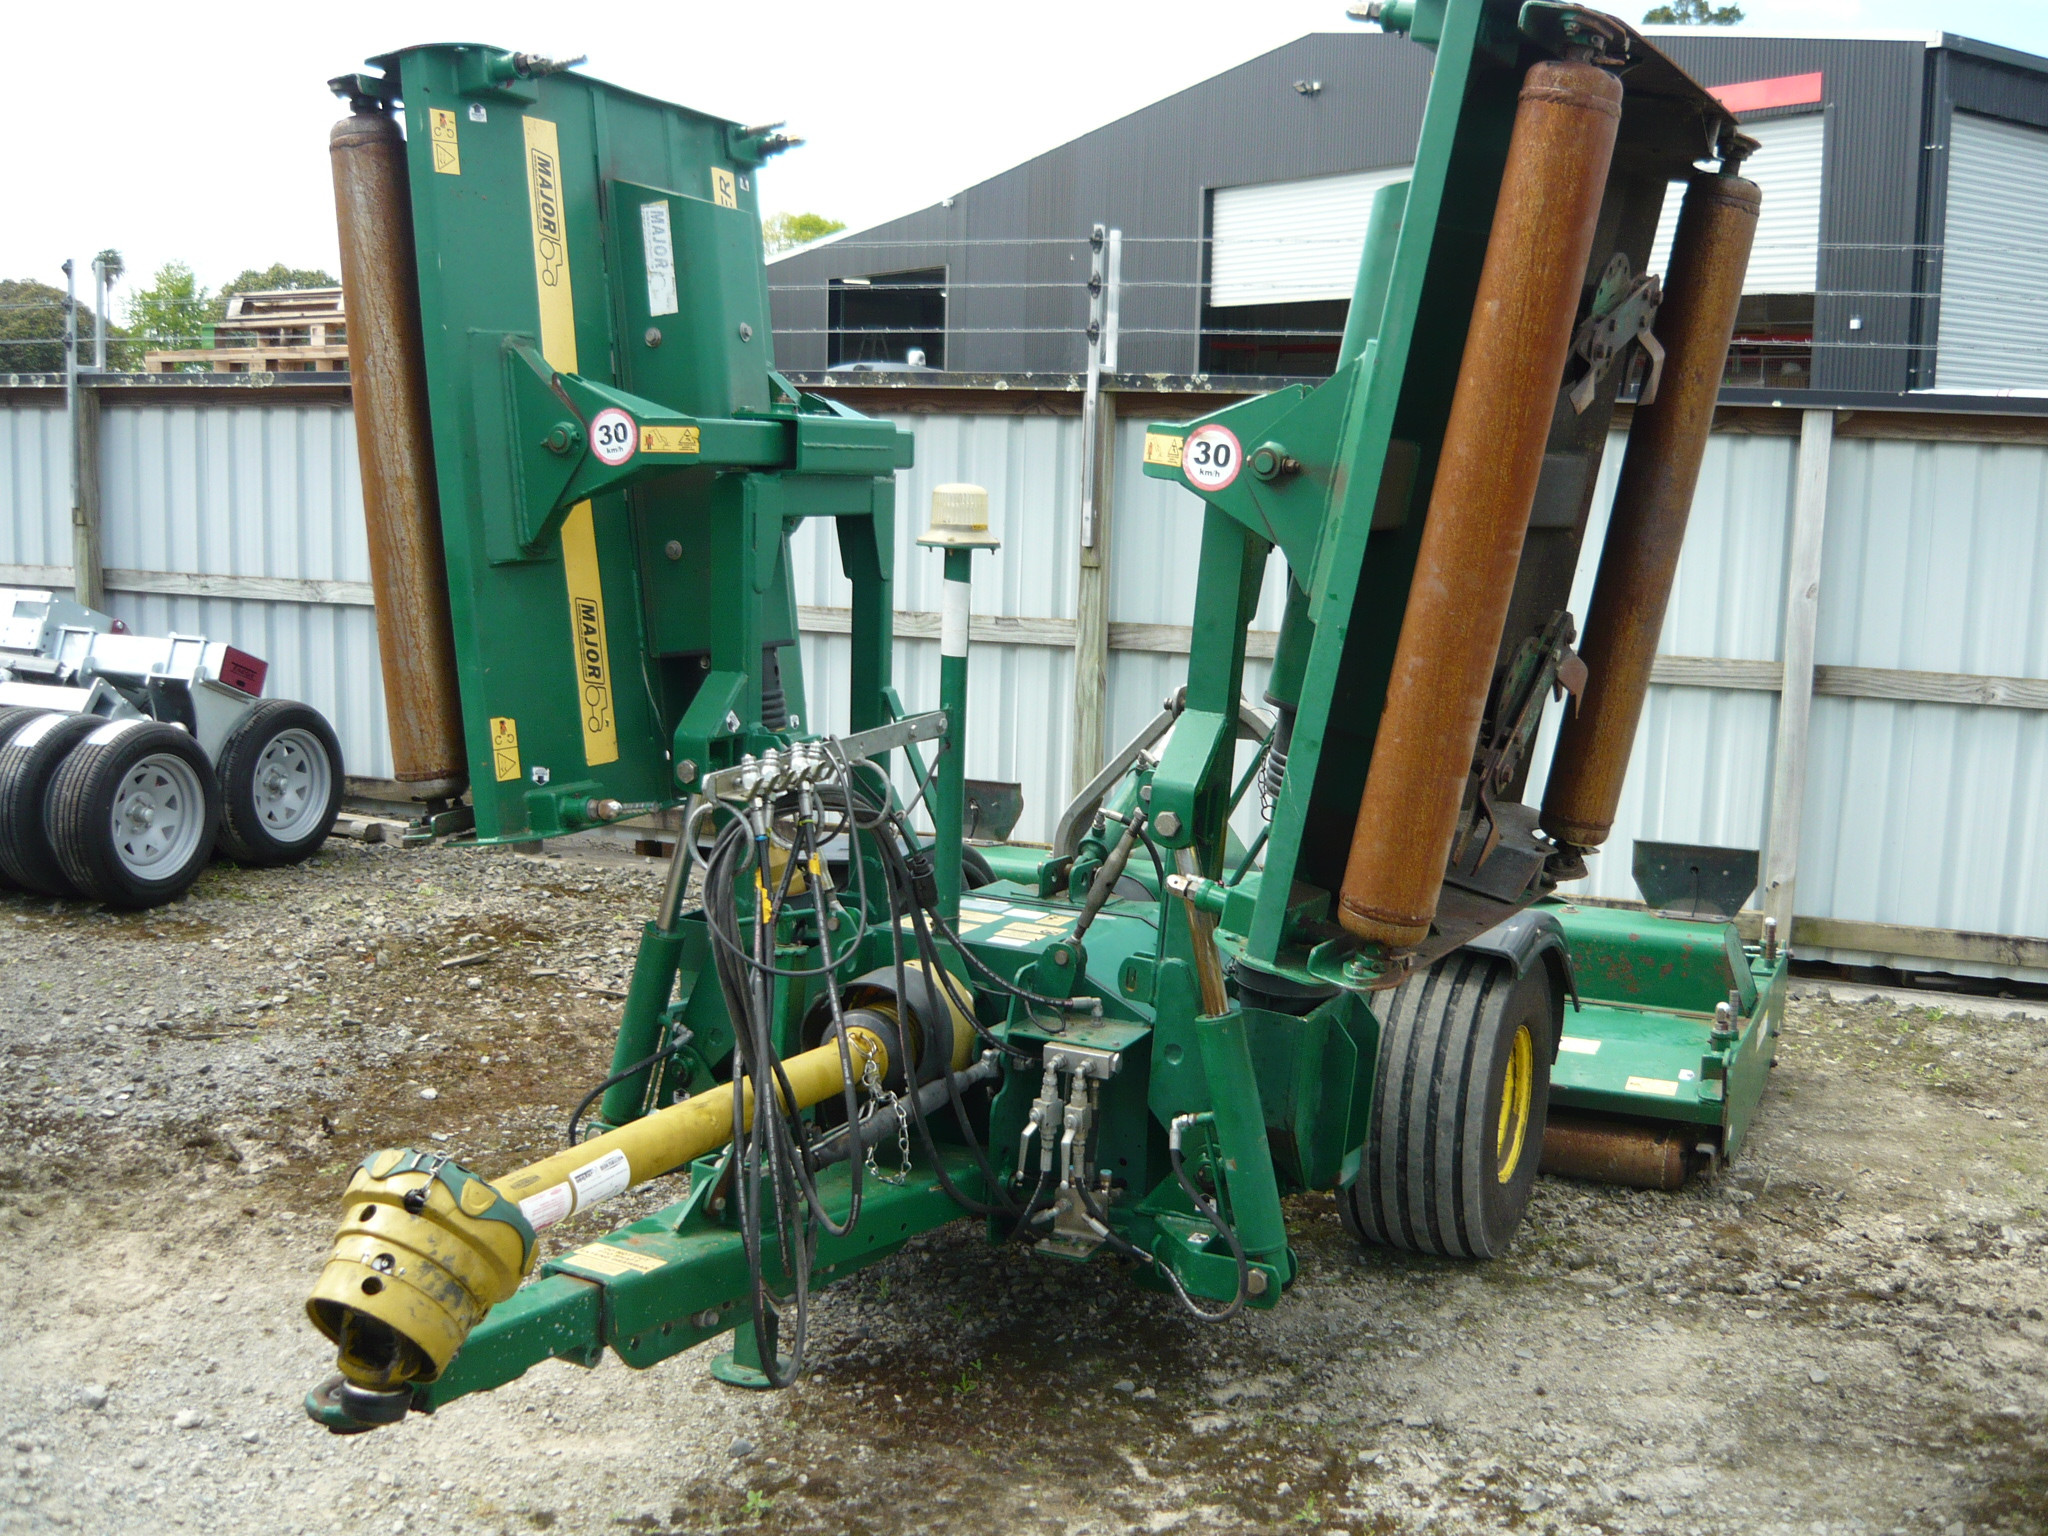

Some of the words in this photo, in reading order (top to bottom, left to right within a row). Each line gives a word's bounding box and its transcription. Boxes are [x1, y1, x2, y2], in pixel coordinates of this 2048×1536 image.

[537, 156, 557, 235] MAJOR
[650, 210, 669, 269] MAJOR
[598, 422, 628, 446] 30
[1193, 441, 1231, 468] 30
[1199, 468, 1220, 478] km/h
[581, 604, 601, 679] MAJOR
